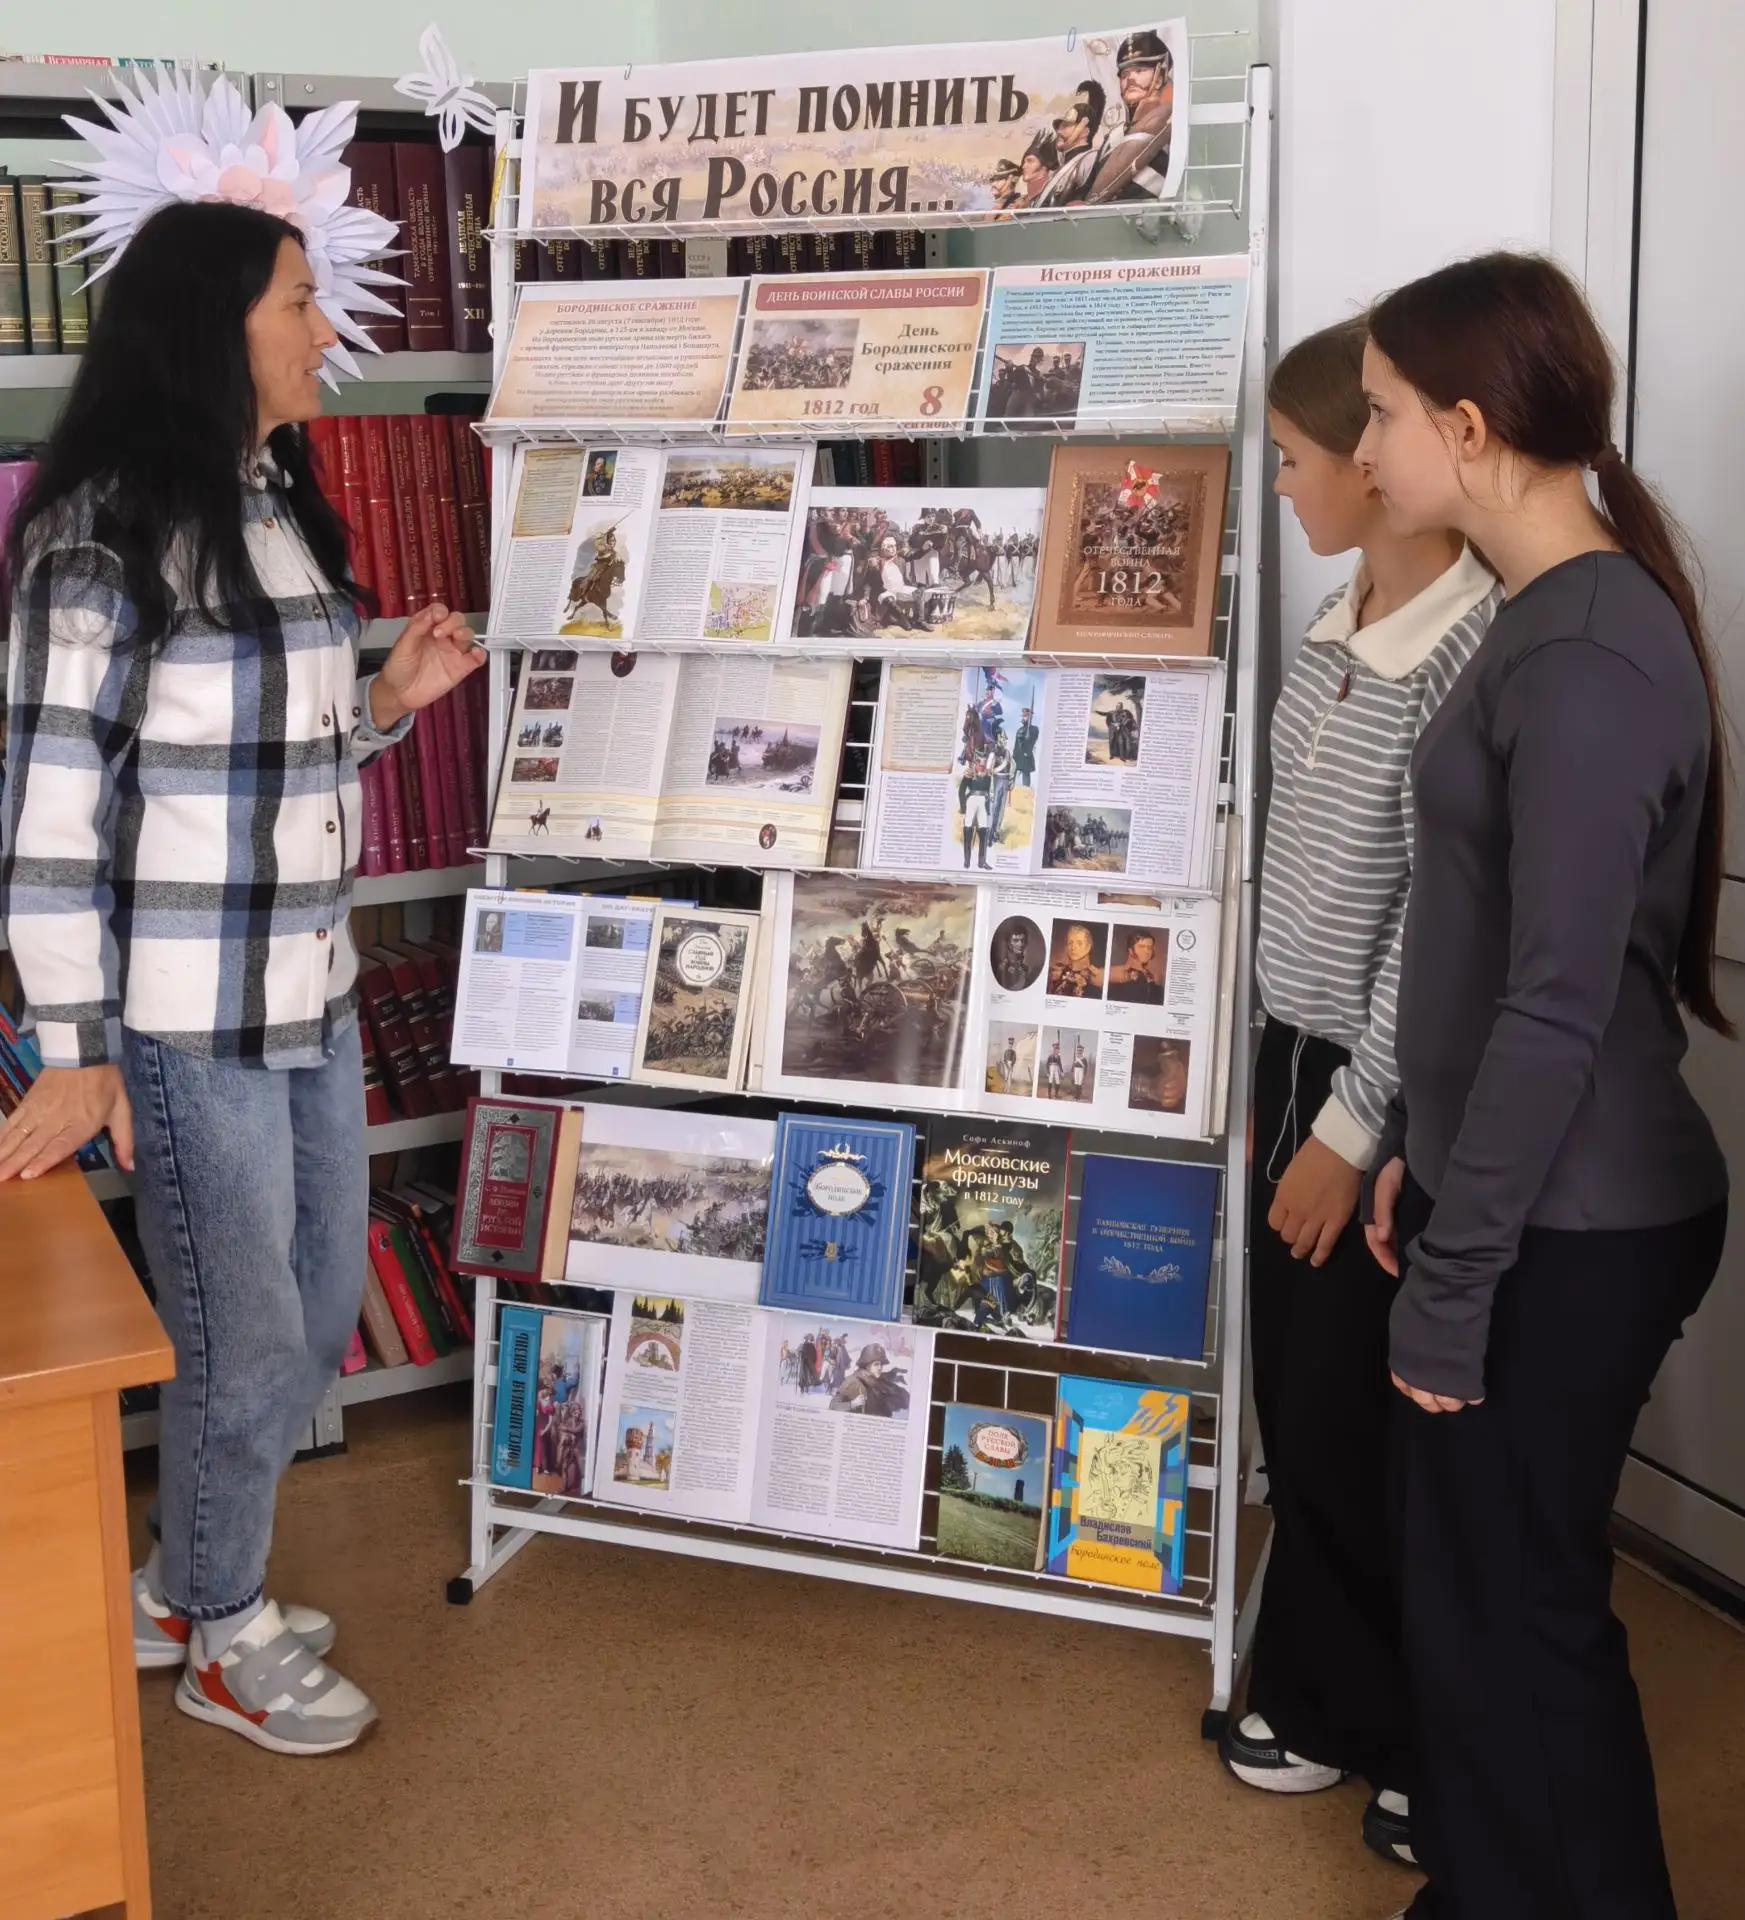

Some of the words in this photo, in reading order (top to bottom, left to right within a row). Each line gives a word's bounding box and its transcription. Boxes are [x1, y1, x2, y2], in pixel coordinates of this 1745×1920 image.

[556, 80, 602, 144] И
[622, 89, 777, 144] БУДЕТ
[797, 74, 1030, 133] ПОМНИТЬ
[590, 176, 681, 224] ВСЯ
[458, 210, 467, 254] ВЕЛИКАЯ
[465, 193, 477, 272] ОТЕЧЕСТВЕННАЯ
[1040, 267, 1113, 284] История
[1117, 264, 1202, 282] сражения
[766, 290, 799, 303] ДЕНЬ
[801, 288, 869, 301] ВОИНСКОЙ
[869, 287, 913, 300] СЛАВЫ
[915, 286, 965, 299] РОССИИ
[557, 302, 636, 315] БОРОДИНСКОЕ
[638, 301, 698, 312] СРАЖЕНИЕ
[897, 323, 940, 340] День
[861, 340, 972, 358] Бородинского
[874, 359, 952, 375] сражения
[802, 399, 843, 417] 1812
[849, 401, 880, 417] год
[919, 385, 945, 416] 8
[1083, 546, 1180, 556] ОТЕЧЕСТВЕННАЯ
[1110, 556, 1151, 567] ВОЙНА
[1096, 571, 1163, 594] 1812
[1111, 597, 1141, 607] ГОДА
[962, 1134, 987, 1145] Софи
[990, 1136, 1031, 1149] Аскиноф
[944, 1148, 1050, 1174] Московские
[952, 1168, 1039, 1191] французы
[964, 1191, 971, 1200] в
[974, 1190, 999, 1204] 1812
[1001, 1195, 1025, 1209] году
[514, 1332, 530, 1375] ЖИЗНЬ
[506, 1380, 526, 1469] ПОВСЕДНЕВНАЯ
[981, 1436, 1018, 1449] РУССКОЙ
[984, 1444, 1011, 1455] СЛАВЫ
[1080, 1515, 1132, 1535] Владислав
[1096, 1529, 1152, 1550] Бахревский
[1070, 1544, 1132, 1568] Бородинское
[1136, 1557, 1161, 1571] поле
